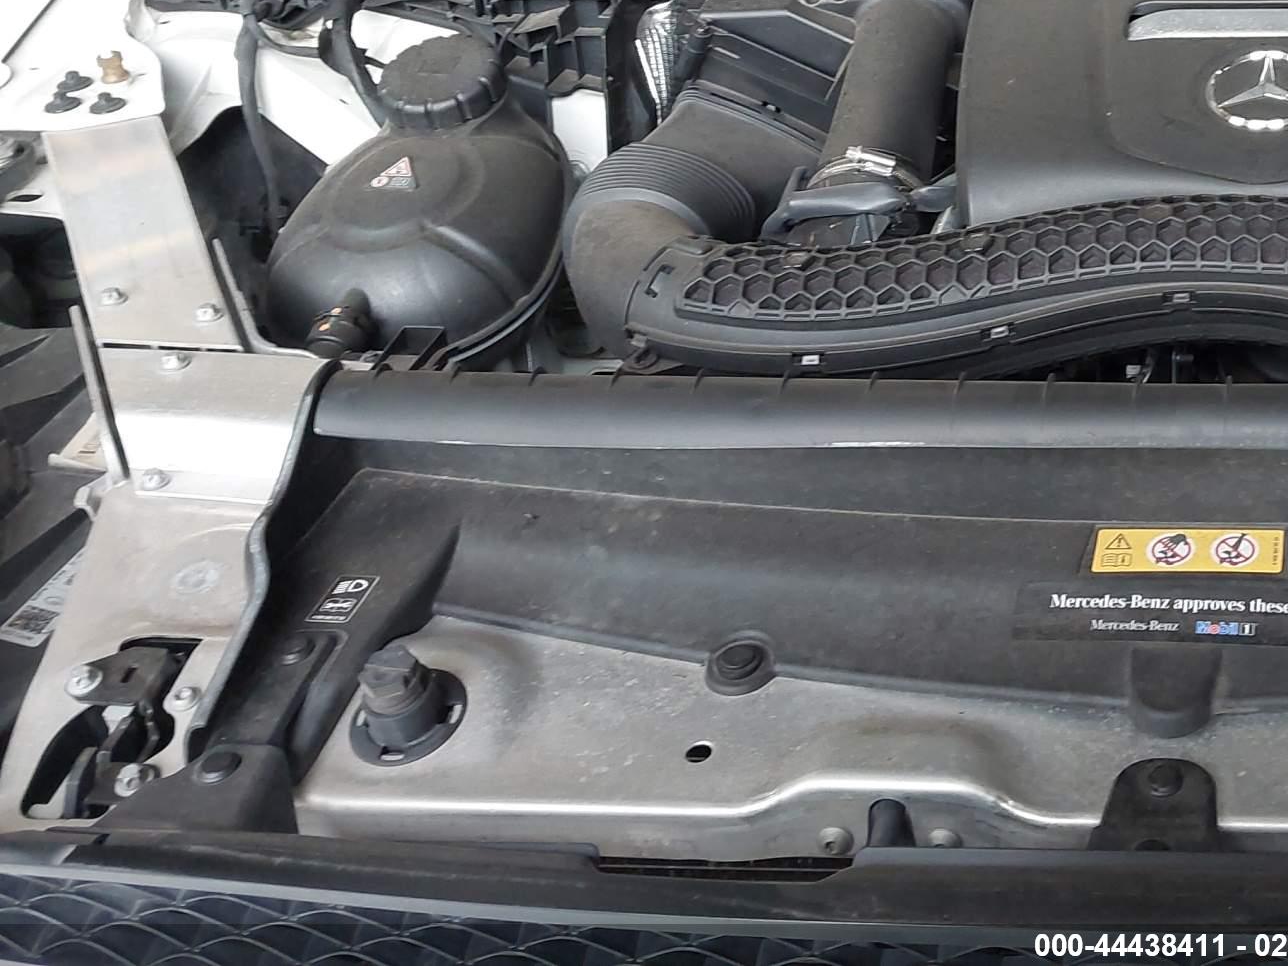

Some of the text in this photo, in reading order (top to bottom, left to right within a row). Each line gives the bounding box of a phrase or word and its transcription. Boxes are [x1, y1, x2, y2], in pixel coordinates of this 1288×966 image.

[1050, 593, 1171, 609] Mercedes-Benz
[1173, 598, 1246, 614] approves
[1090, 619, 1181, 632] Mercedes-Benz
